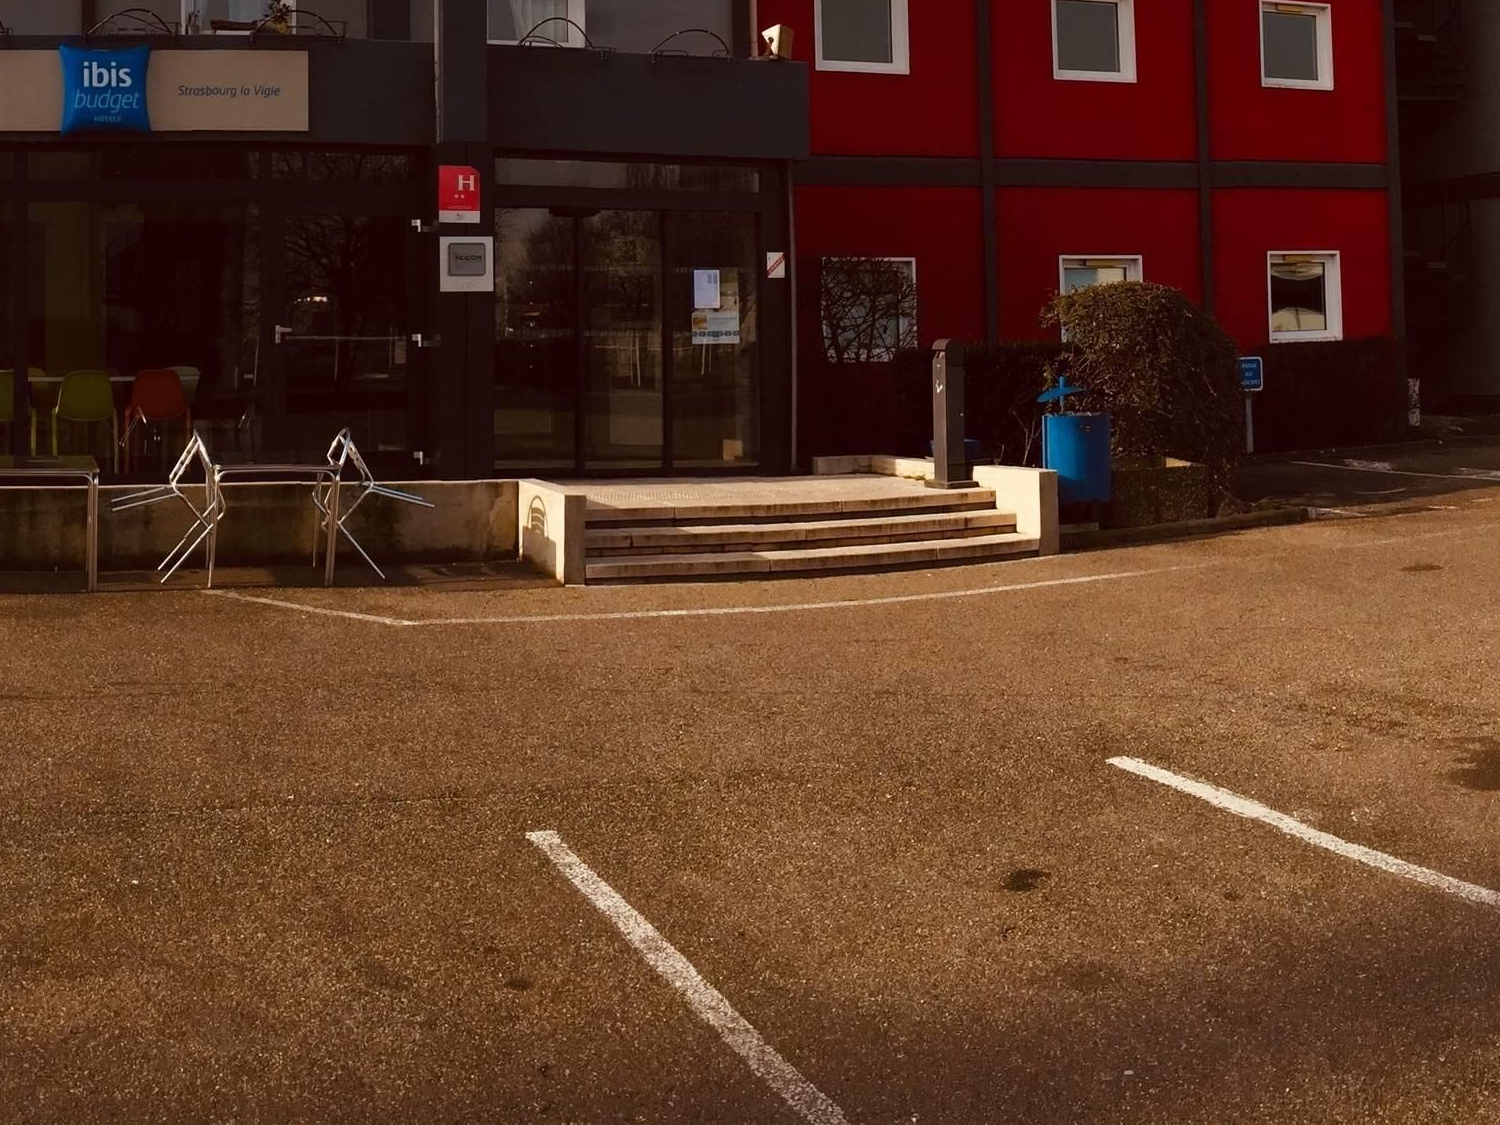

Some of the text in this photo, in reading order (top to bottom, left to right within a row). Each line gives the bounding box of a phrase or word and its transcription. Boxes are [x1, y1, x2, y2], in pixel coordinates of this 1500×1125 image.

[83, 61, 133, 88] ibis
[74, 88, 141, 114] budget
[178, 85, 281, 99] Strasbourg la Vigie
[93, 115, 122, 123] HOTELS
[457, 174, 476, 192] H
